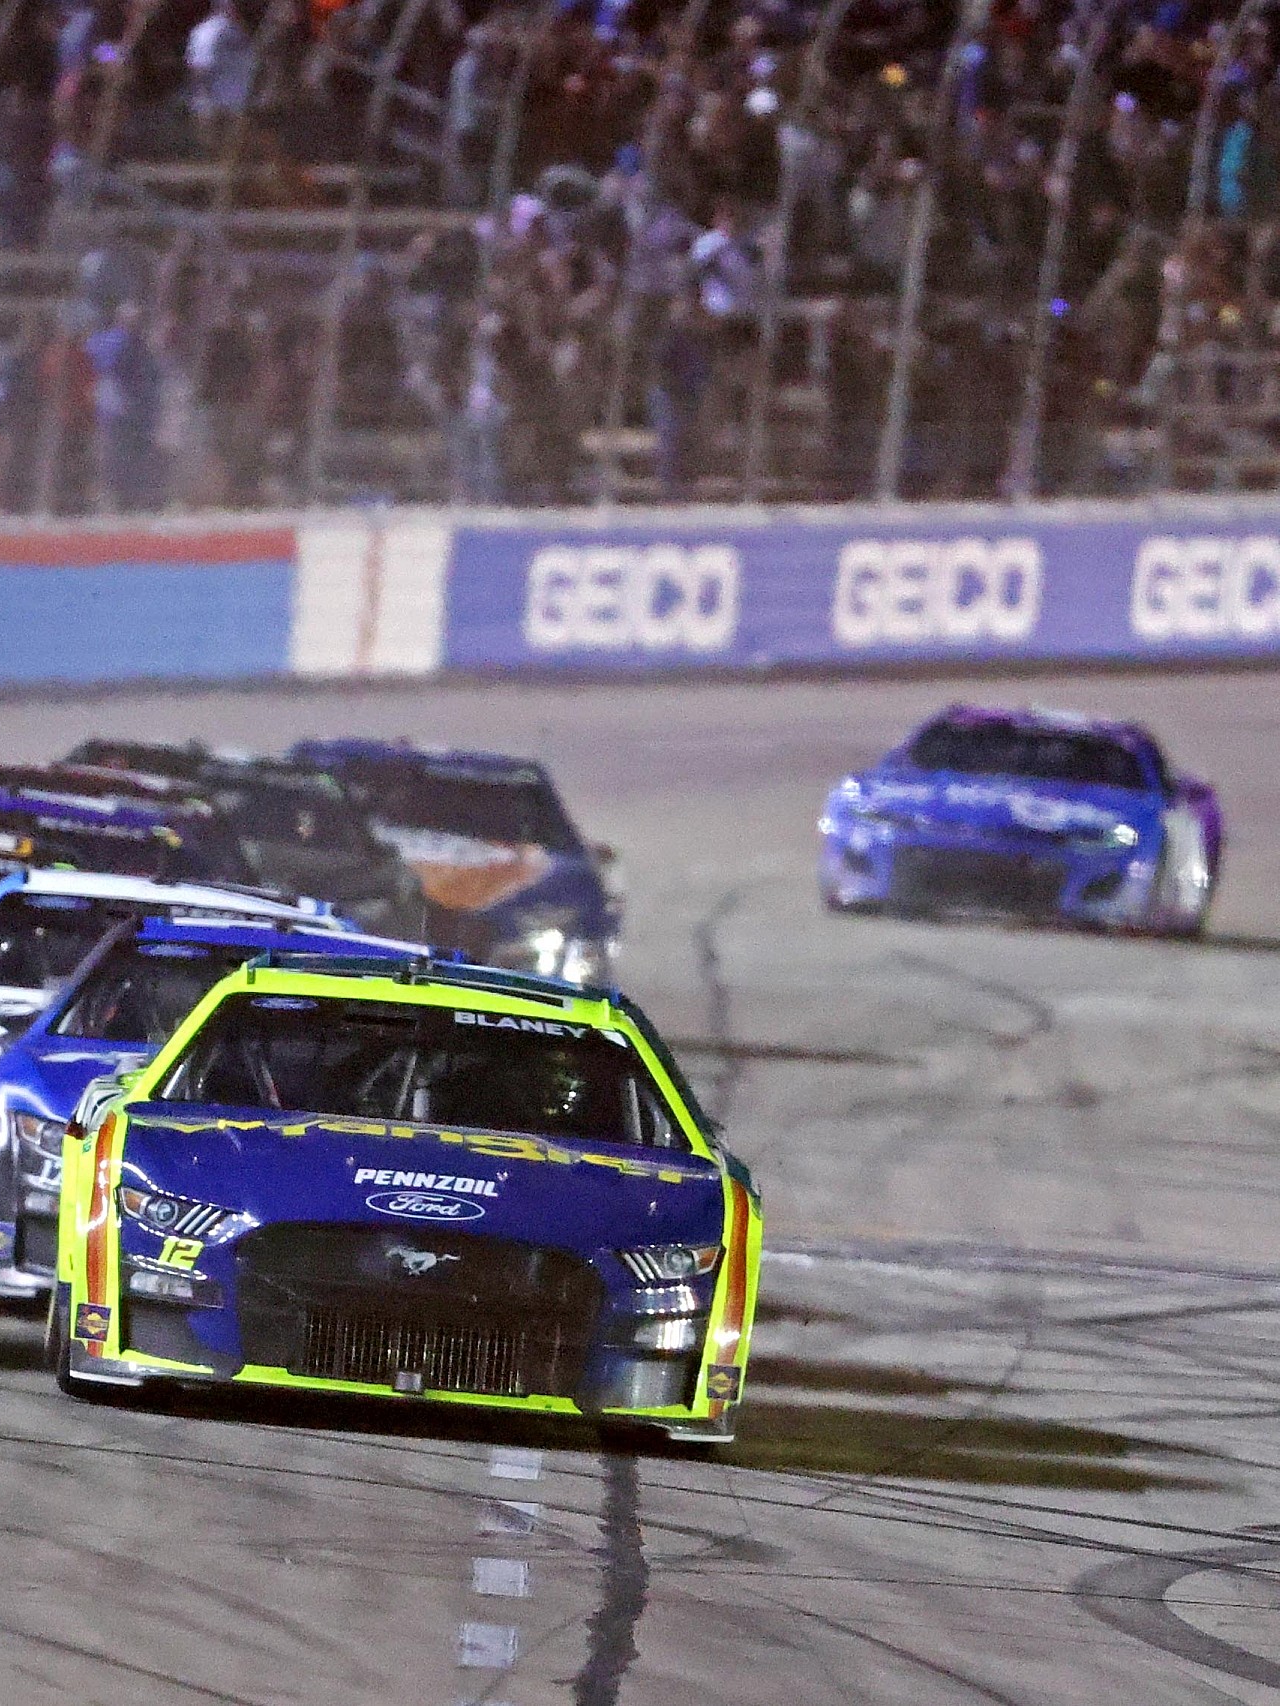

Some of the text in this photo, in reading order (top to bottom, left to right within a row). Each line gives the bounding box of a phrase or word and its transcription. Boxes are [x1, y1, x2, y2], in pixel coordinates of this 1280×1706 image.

[524, 543, 741, 652] GEICO
[831, 538, 1043, 648] GEICO
[454, 1010, 586, 1039] BLANEY
[354, 1167, 499, 1198] PENNZOIL
[388, 1193, 462, 1217] Ford
[158, 1235, 205, 1271] 12
